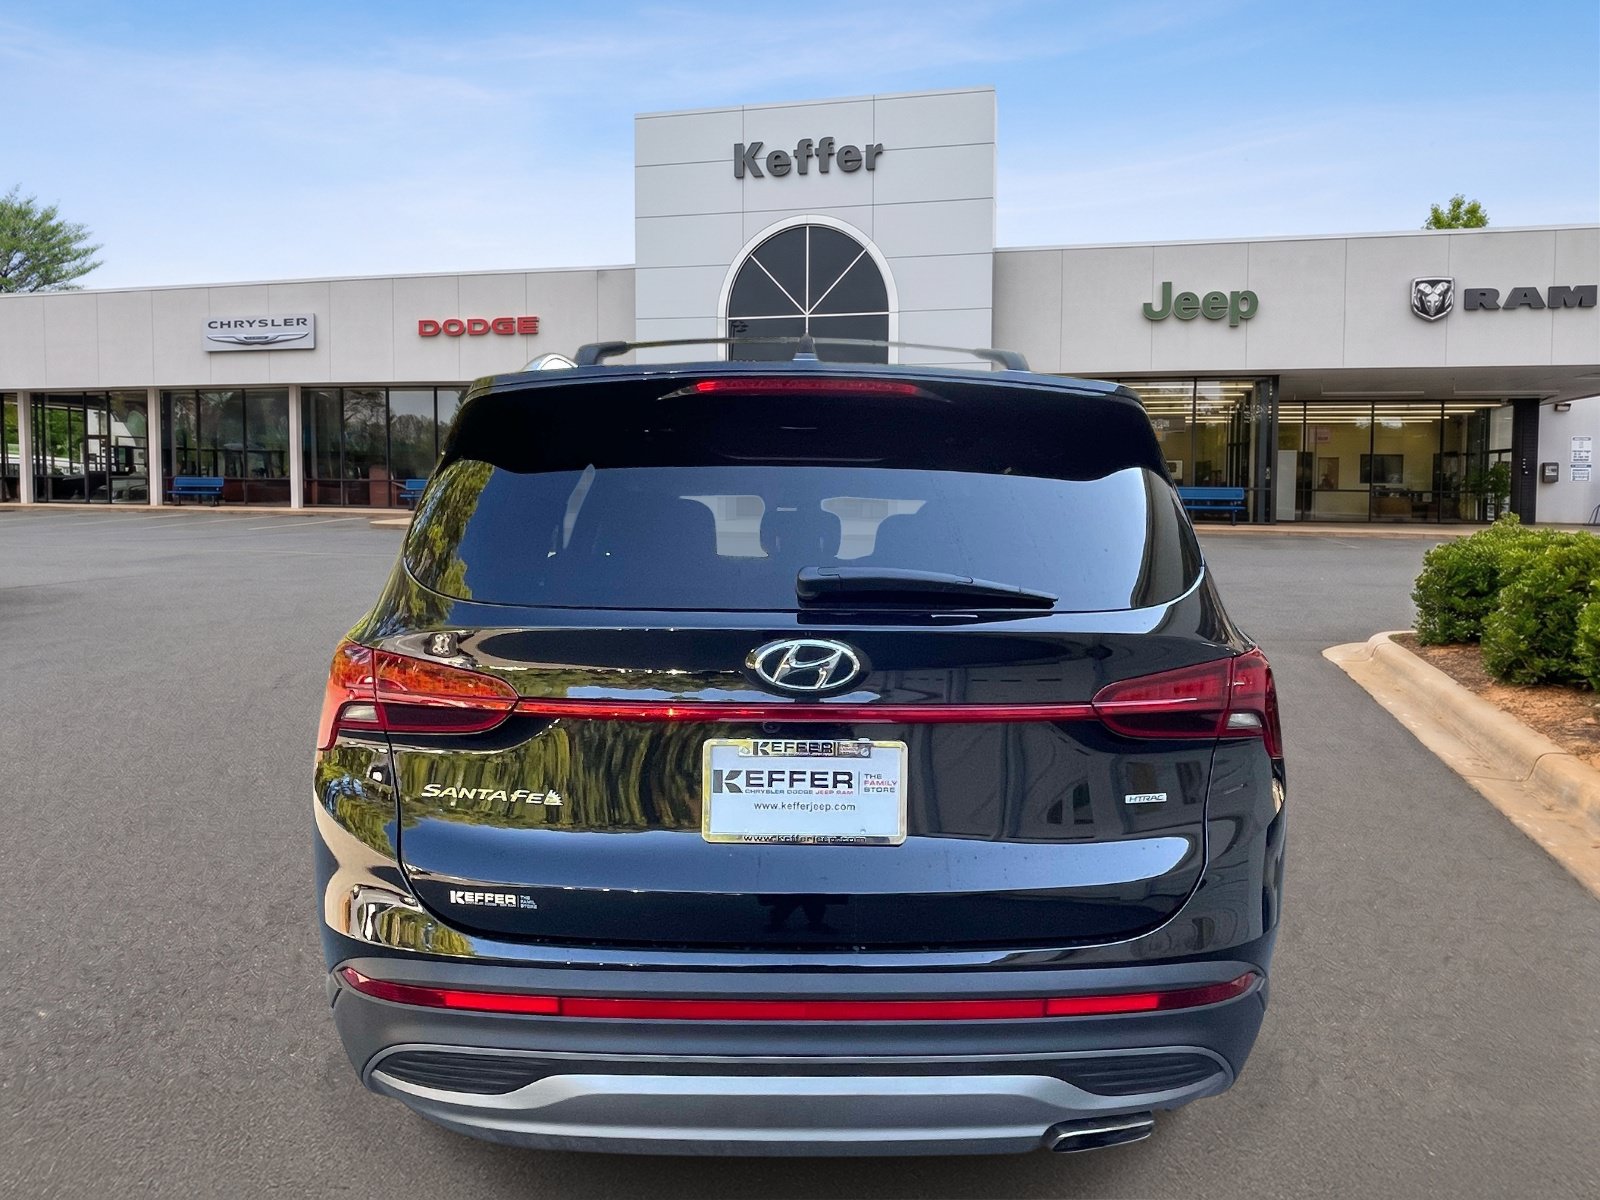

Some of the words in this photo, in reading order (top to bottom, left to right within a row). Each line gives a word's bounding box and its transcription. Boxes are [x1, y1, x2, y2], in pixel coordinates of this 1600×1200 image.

[733, 136, 883, 178] Keffer
[1143, 281, 1259, 327] Jeep
[1464, 284, 1598, 311] RAM
[207, 317, 308, 329] CHRYSLER
[418, 316, 539, 337] DODGE
[752, 741, 833, 755] KEFFER
[712, 769, 854, 794] KEFFER
[753, 801, 856, 812] www.kefferjeep.com
[1129, 794, 1164, 802] HTRAC
[449, 890, 517, 905] KEFFER
